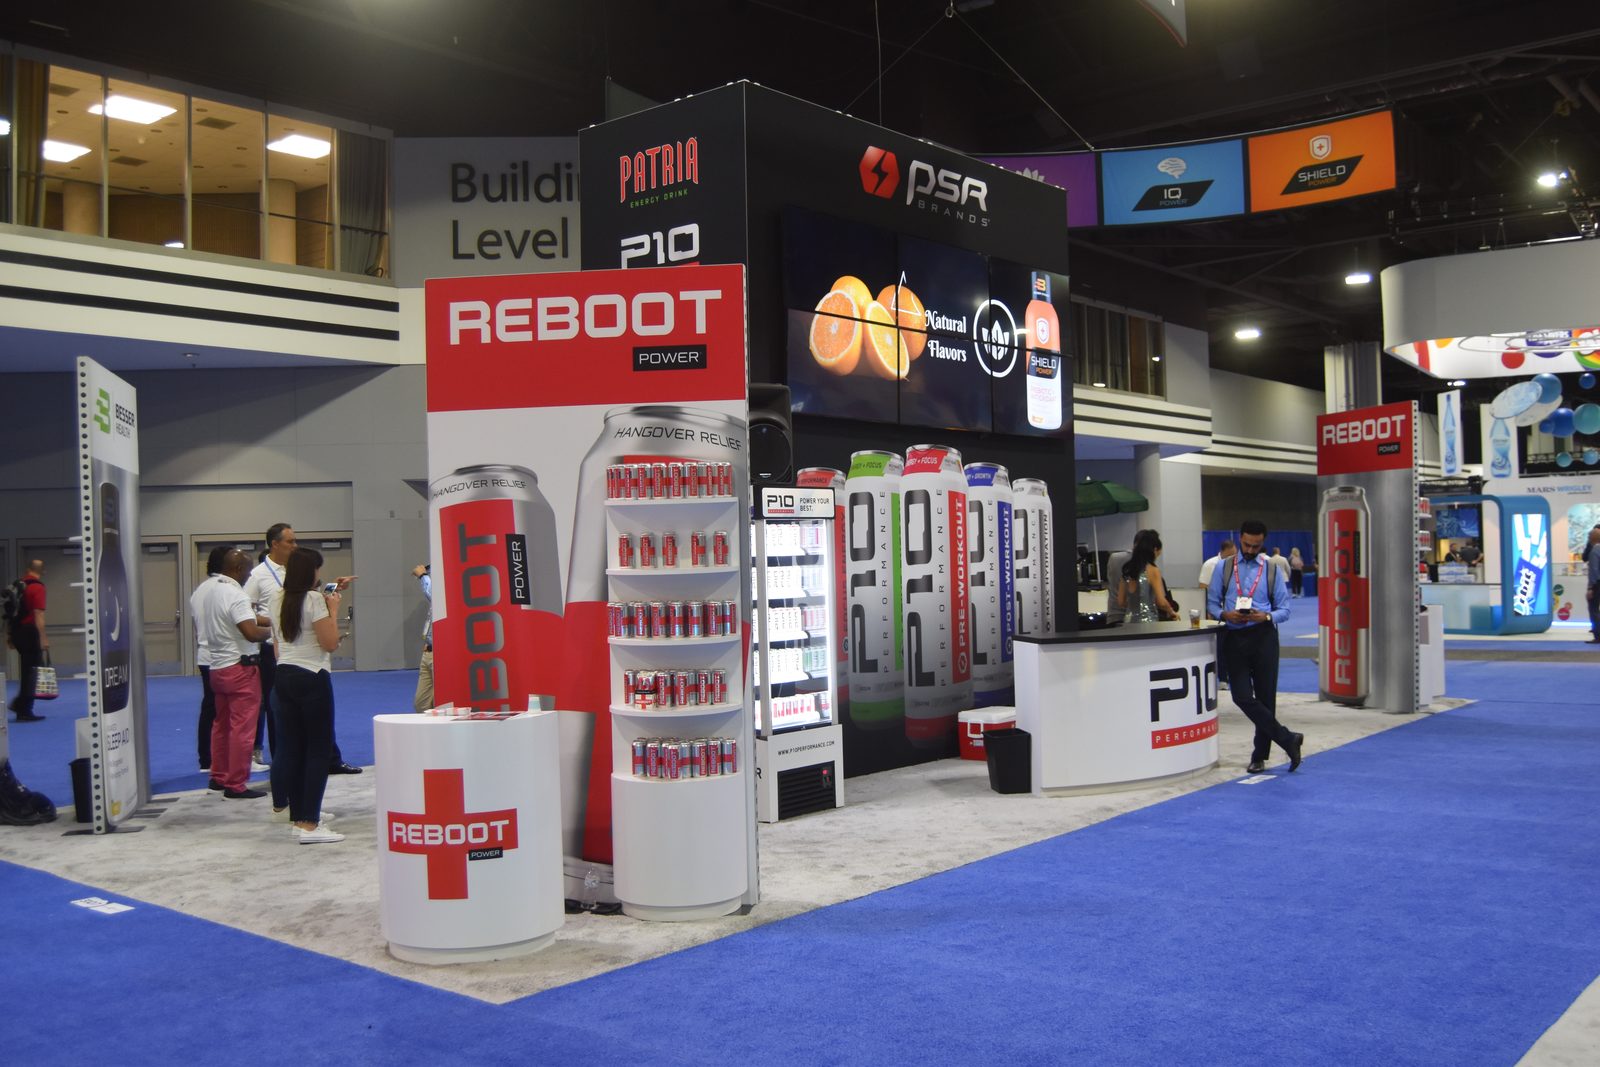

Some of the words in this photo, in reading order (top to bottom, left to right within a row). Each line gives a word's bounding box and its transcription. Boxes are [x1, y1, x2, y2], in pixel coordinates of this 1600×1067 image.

[451, 161, 580, 203] Buildi
[620, 137, 698, 203] PATRIA
[1298, 165, 1346, 182] SHIELD
[1308, 177, 1338, 187] POWER
[630, 196, 660, 208] ENERGY
[664, 189, 688, 200] DRINK
[906, 160, 988, 212] PSR
[1163, 187, 1182, 200] IQ
[452, 217, 568, 260] Level
[621, 223, 699, 269] P10
[449, 289, 722, 345] REBOOT
[925, 310, 967, 334] Natural
[639, 352, 699, 365] POWER
[928, 340, 967, 362] Flavors
[1031, 356, 1057, 369] SHIELD
[115, 403, 136, 428] BESSER
[614, 425, 695, 442] HANGOVER
[700, 431, 742, 451] RELIEF
[1322, 415, 1405, 446] REBOOT
[921, 456, 938, 464] FOCUS
[432, 479, 488, 498] HANGOVER
[491, 478, 527, 489] RELIEF
[767, 495, 795, 508] P10
[1526, 486, 1556, 494] MARS
[511, 541, 526, 599] POWER
[849, 491, 879, 673] P10
[880, 491, 890, 673] PERFORMANCE
[956, 498, 966, 647] PRE-WORKOUT
[987, 500, 997, 666] PERFORMANCE
[1003, 507, 1013, 633] POST-WORKOUT
[904, 489, 935, 687] P10
[936, 489, 947, 687] PERFORMANCE
[458, 523, 510, 712] BOOT
[1334, 522, 1352, 685] REBOOT
[105, 664, 128, 689] DREAM
[392, 819, 510, 845] REBOOT
[471, 850, 501, 859] POWER
